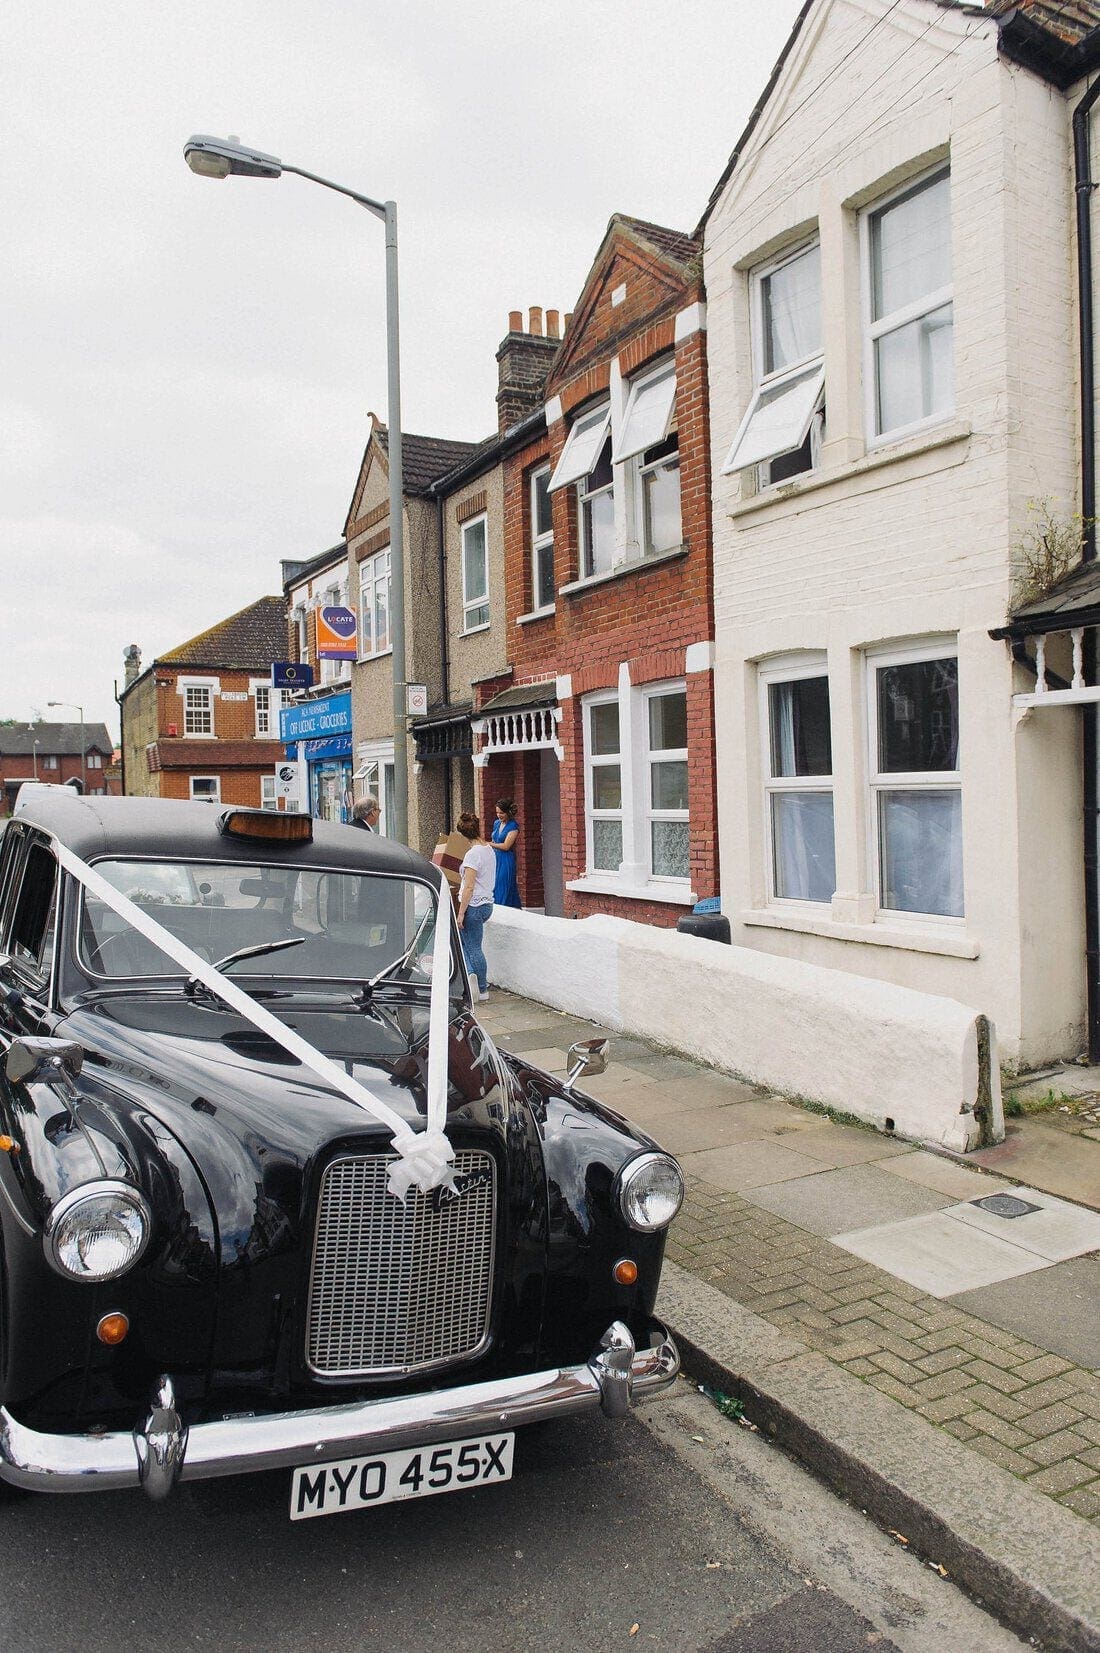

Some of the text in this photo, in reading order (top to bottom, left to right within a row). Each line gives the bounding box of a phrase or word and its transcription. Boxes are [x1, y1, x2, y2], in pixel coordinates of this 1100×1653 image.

[327, 616, 354, 624] LOCATE
[299, 718, 316, 734] LICENCE
[320, 711, 348, 730] GROCERIES
[399, 1439, 508, 1492] 455X
